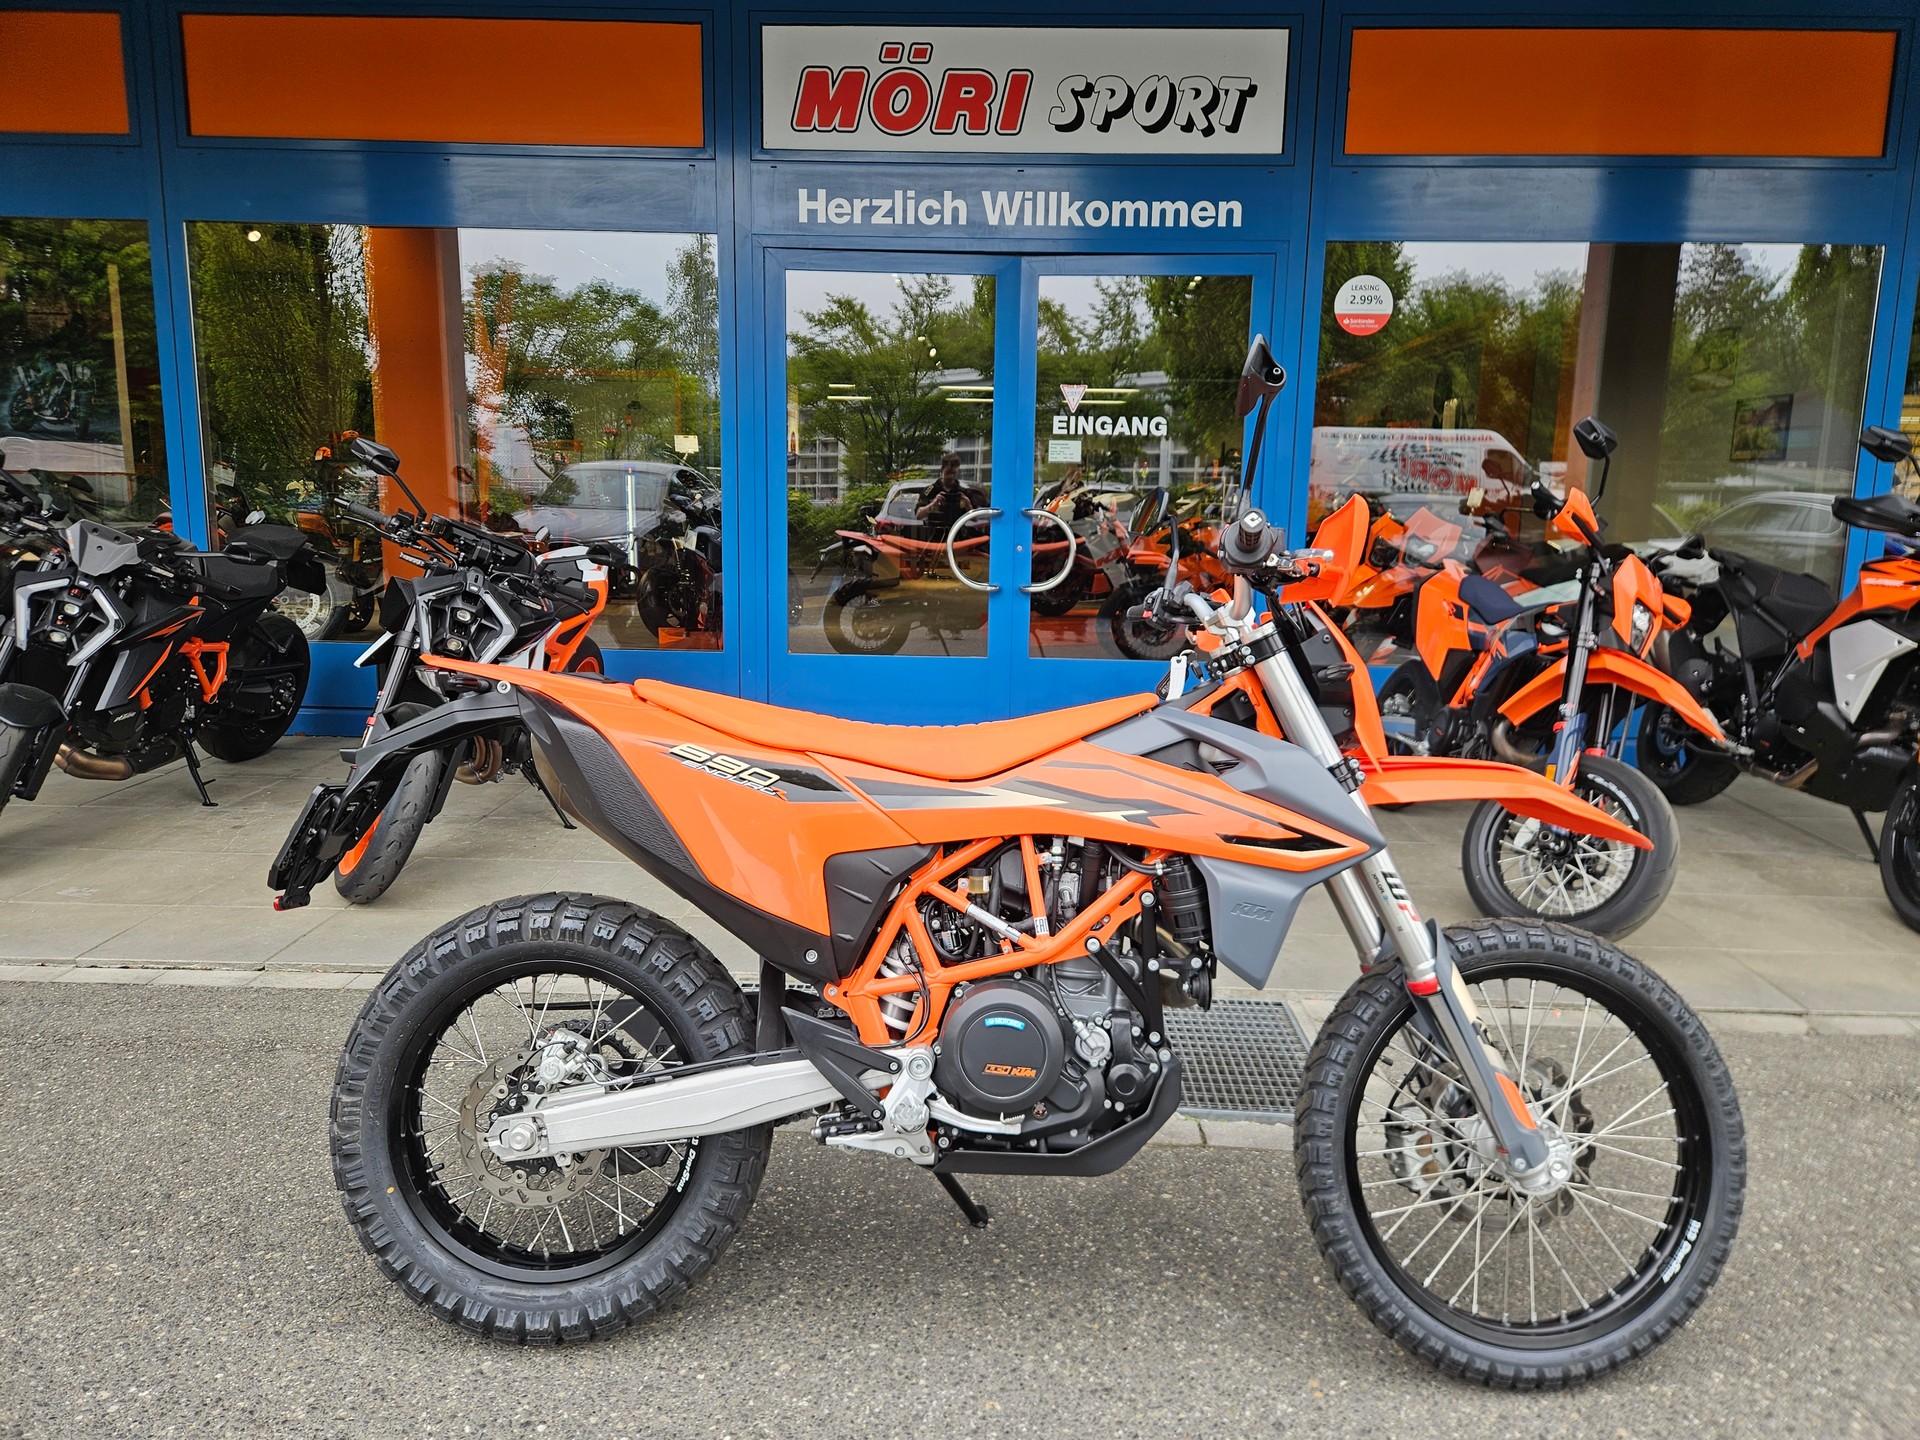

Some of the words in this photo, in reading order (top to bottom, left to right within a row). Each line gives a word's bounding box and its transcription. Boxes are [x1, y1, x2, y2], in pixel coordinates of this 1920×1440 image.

[791, 42, 1034, 137] MÖRI
[1048, 74, 1258, 138] SPORT
[798, 188, 967, 225] Herzlich
[981, 190, 1242, 227] Willkommen
[1350, 294, 1384, 305] 2.99%
[1052, 415, 1168, 436] EINGANG
[669, 743, 781, 787] 690
[681, 760, 776, 796] ENDURO
[1230, 902, 1274, 922] KTM
[1011, 1066, 1037, 1078] KTM
